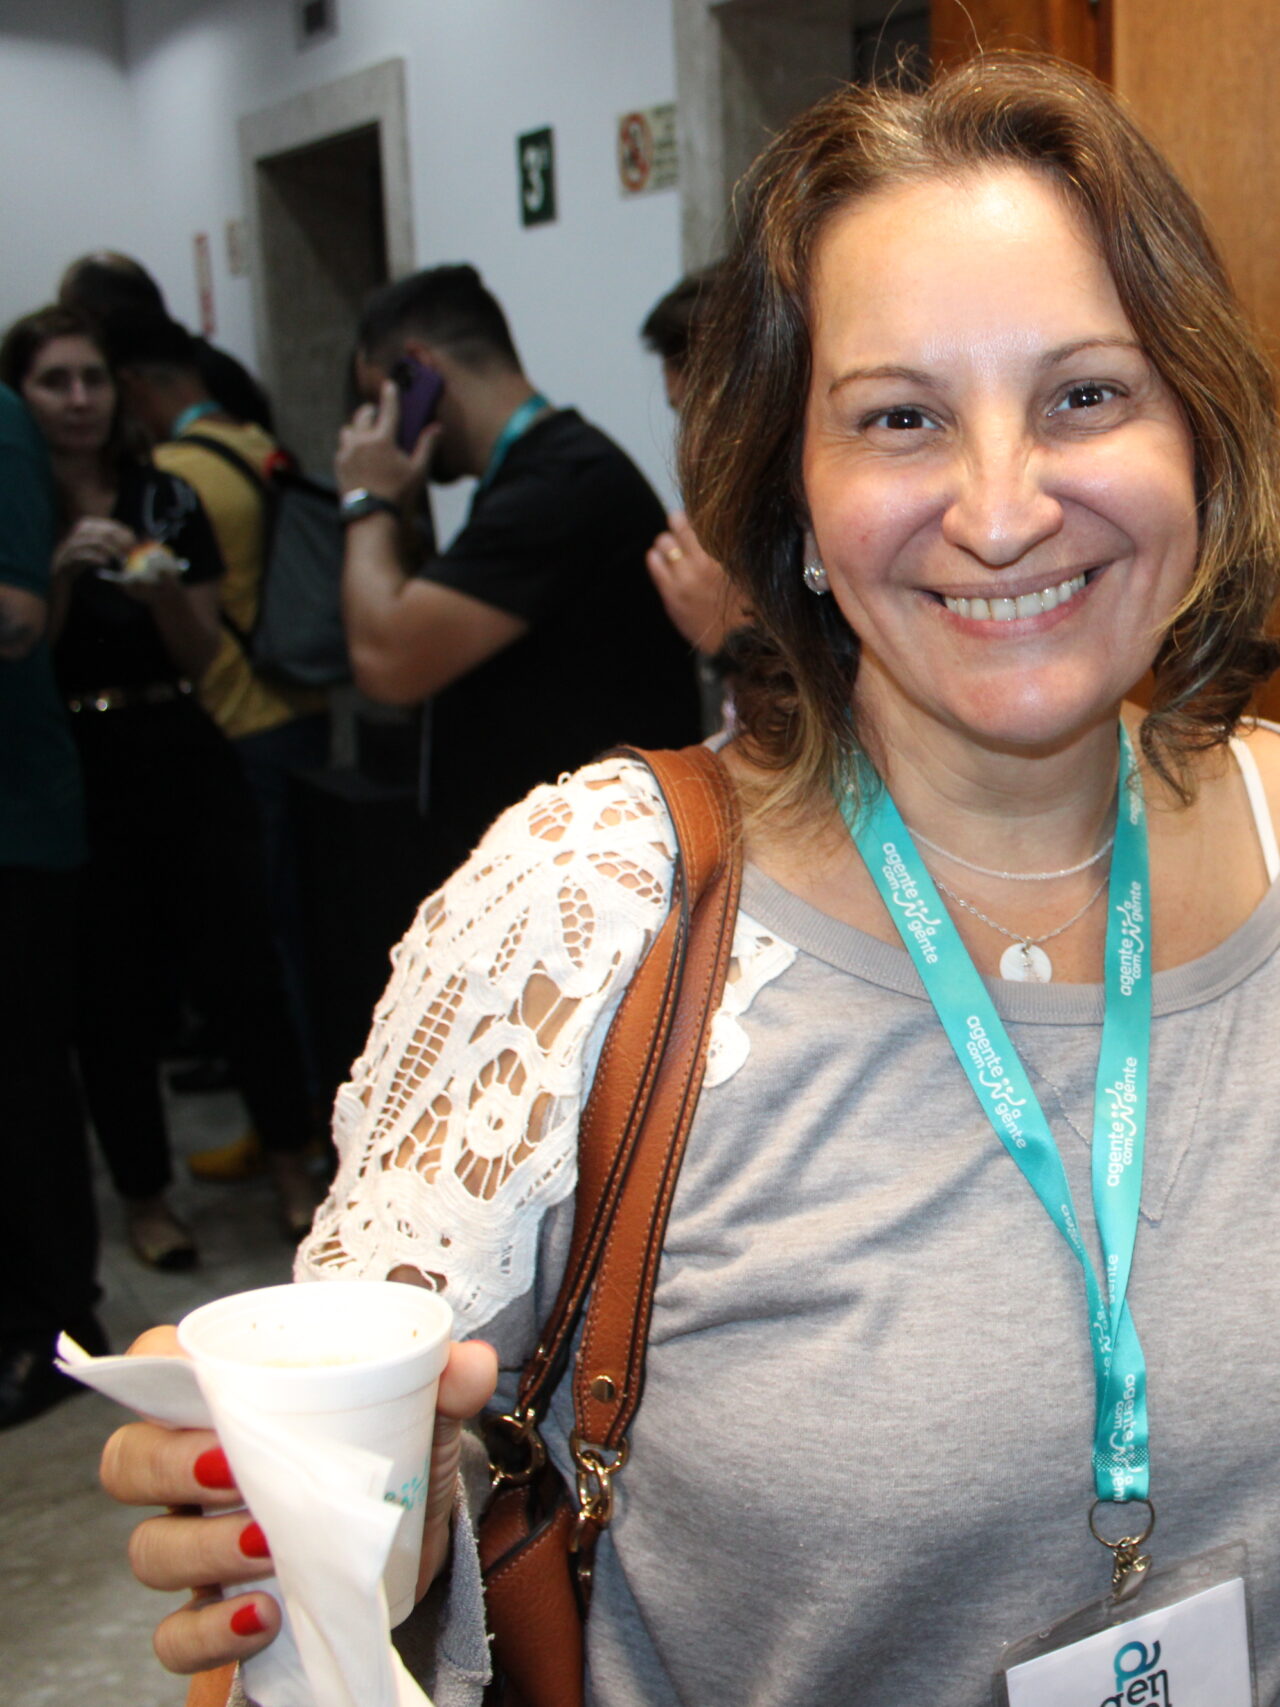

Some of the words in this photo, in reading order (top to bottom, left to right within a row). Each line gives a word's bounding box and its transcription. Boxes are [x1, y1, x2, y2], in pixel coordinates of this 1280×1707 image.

[882, 842, 918, 899] agente
[882, 866, 900, 890] com
[1130, 881, 1143, 922] gente
[907, 920, 938, 964] gente
[1118, 938, 1134, 996] agente
[1132, 954, 1142, 979] com
[966, 1016, 1003, 1078] agente
[966, 1041, 985, 1069] com
[1122, 1056, 1137, 1103] gente
[995, 1102, 1026, 1148] gente
[1106, 1121, 1124, 1187] agente
[1123, 1137, 1134, 1165] com
[1114, 1400, 1124, 1429] com
[1122, 1374, 1137, 1442] agente
[1110, 1466, 1126, 1502] gen
